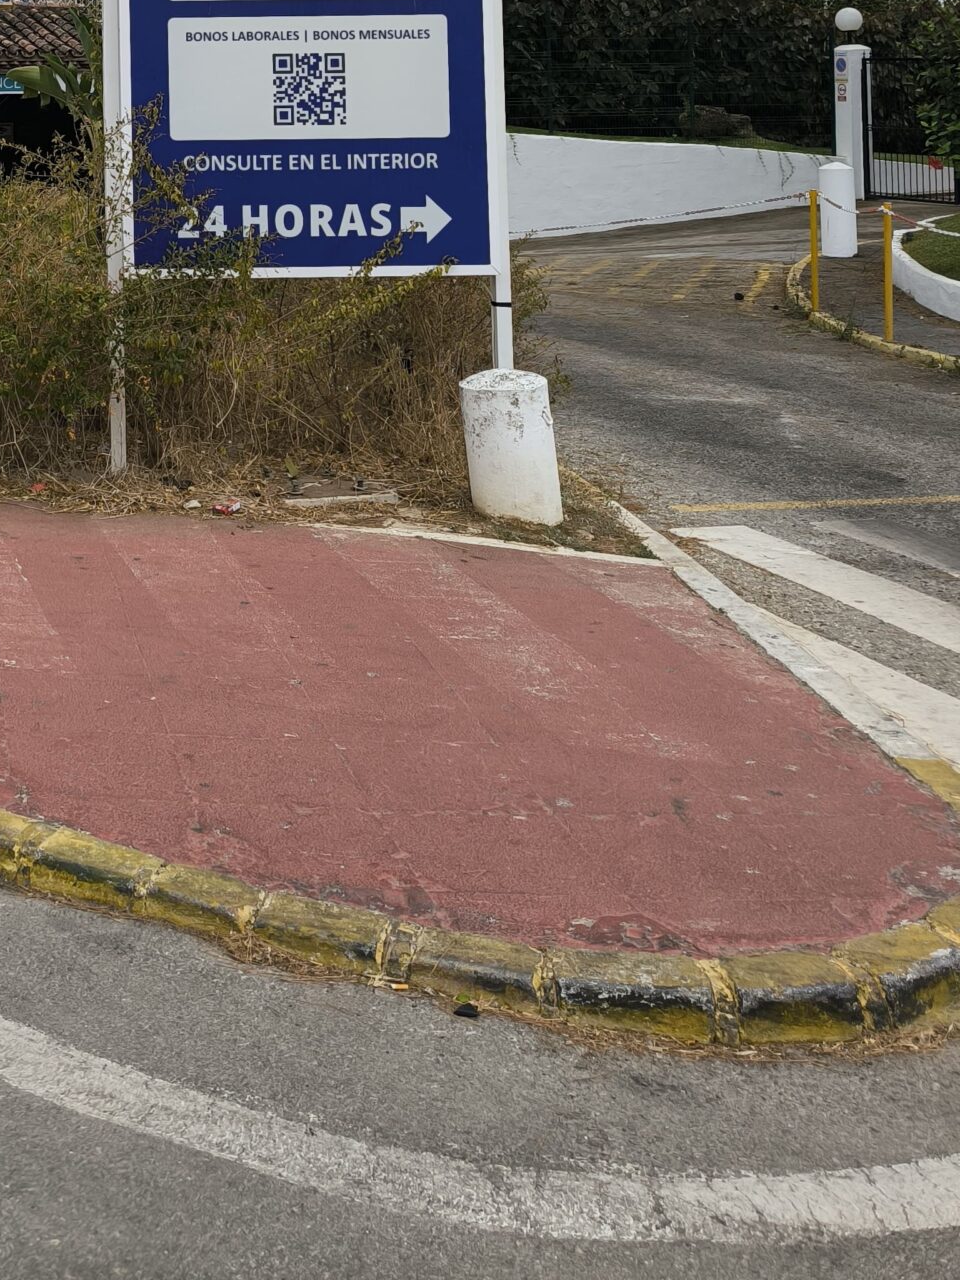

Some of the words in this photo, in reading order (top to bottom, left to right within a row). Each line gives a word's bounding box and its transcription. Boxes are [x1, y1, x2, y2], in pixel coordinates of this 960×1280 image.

[185, 31, 229, 43] BONOS
[231, 30, 300, 42] LABORALES
[312, 30, 356, 41] BONOS
[358, 28, 431, 41] MENSUALES
[183, 154, 283, 172] CONSULTE
[288, 153, 314, 171] EN
[320, 153, 342, 170] EL
[346, 152, 439, 170] INTERIOR
[177, 204, 228, 239] 24
[241, 203, 392, 238] HORAS
